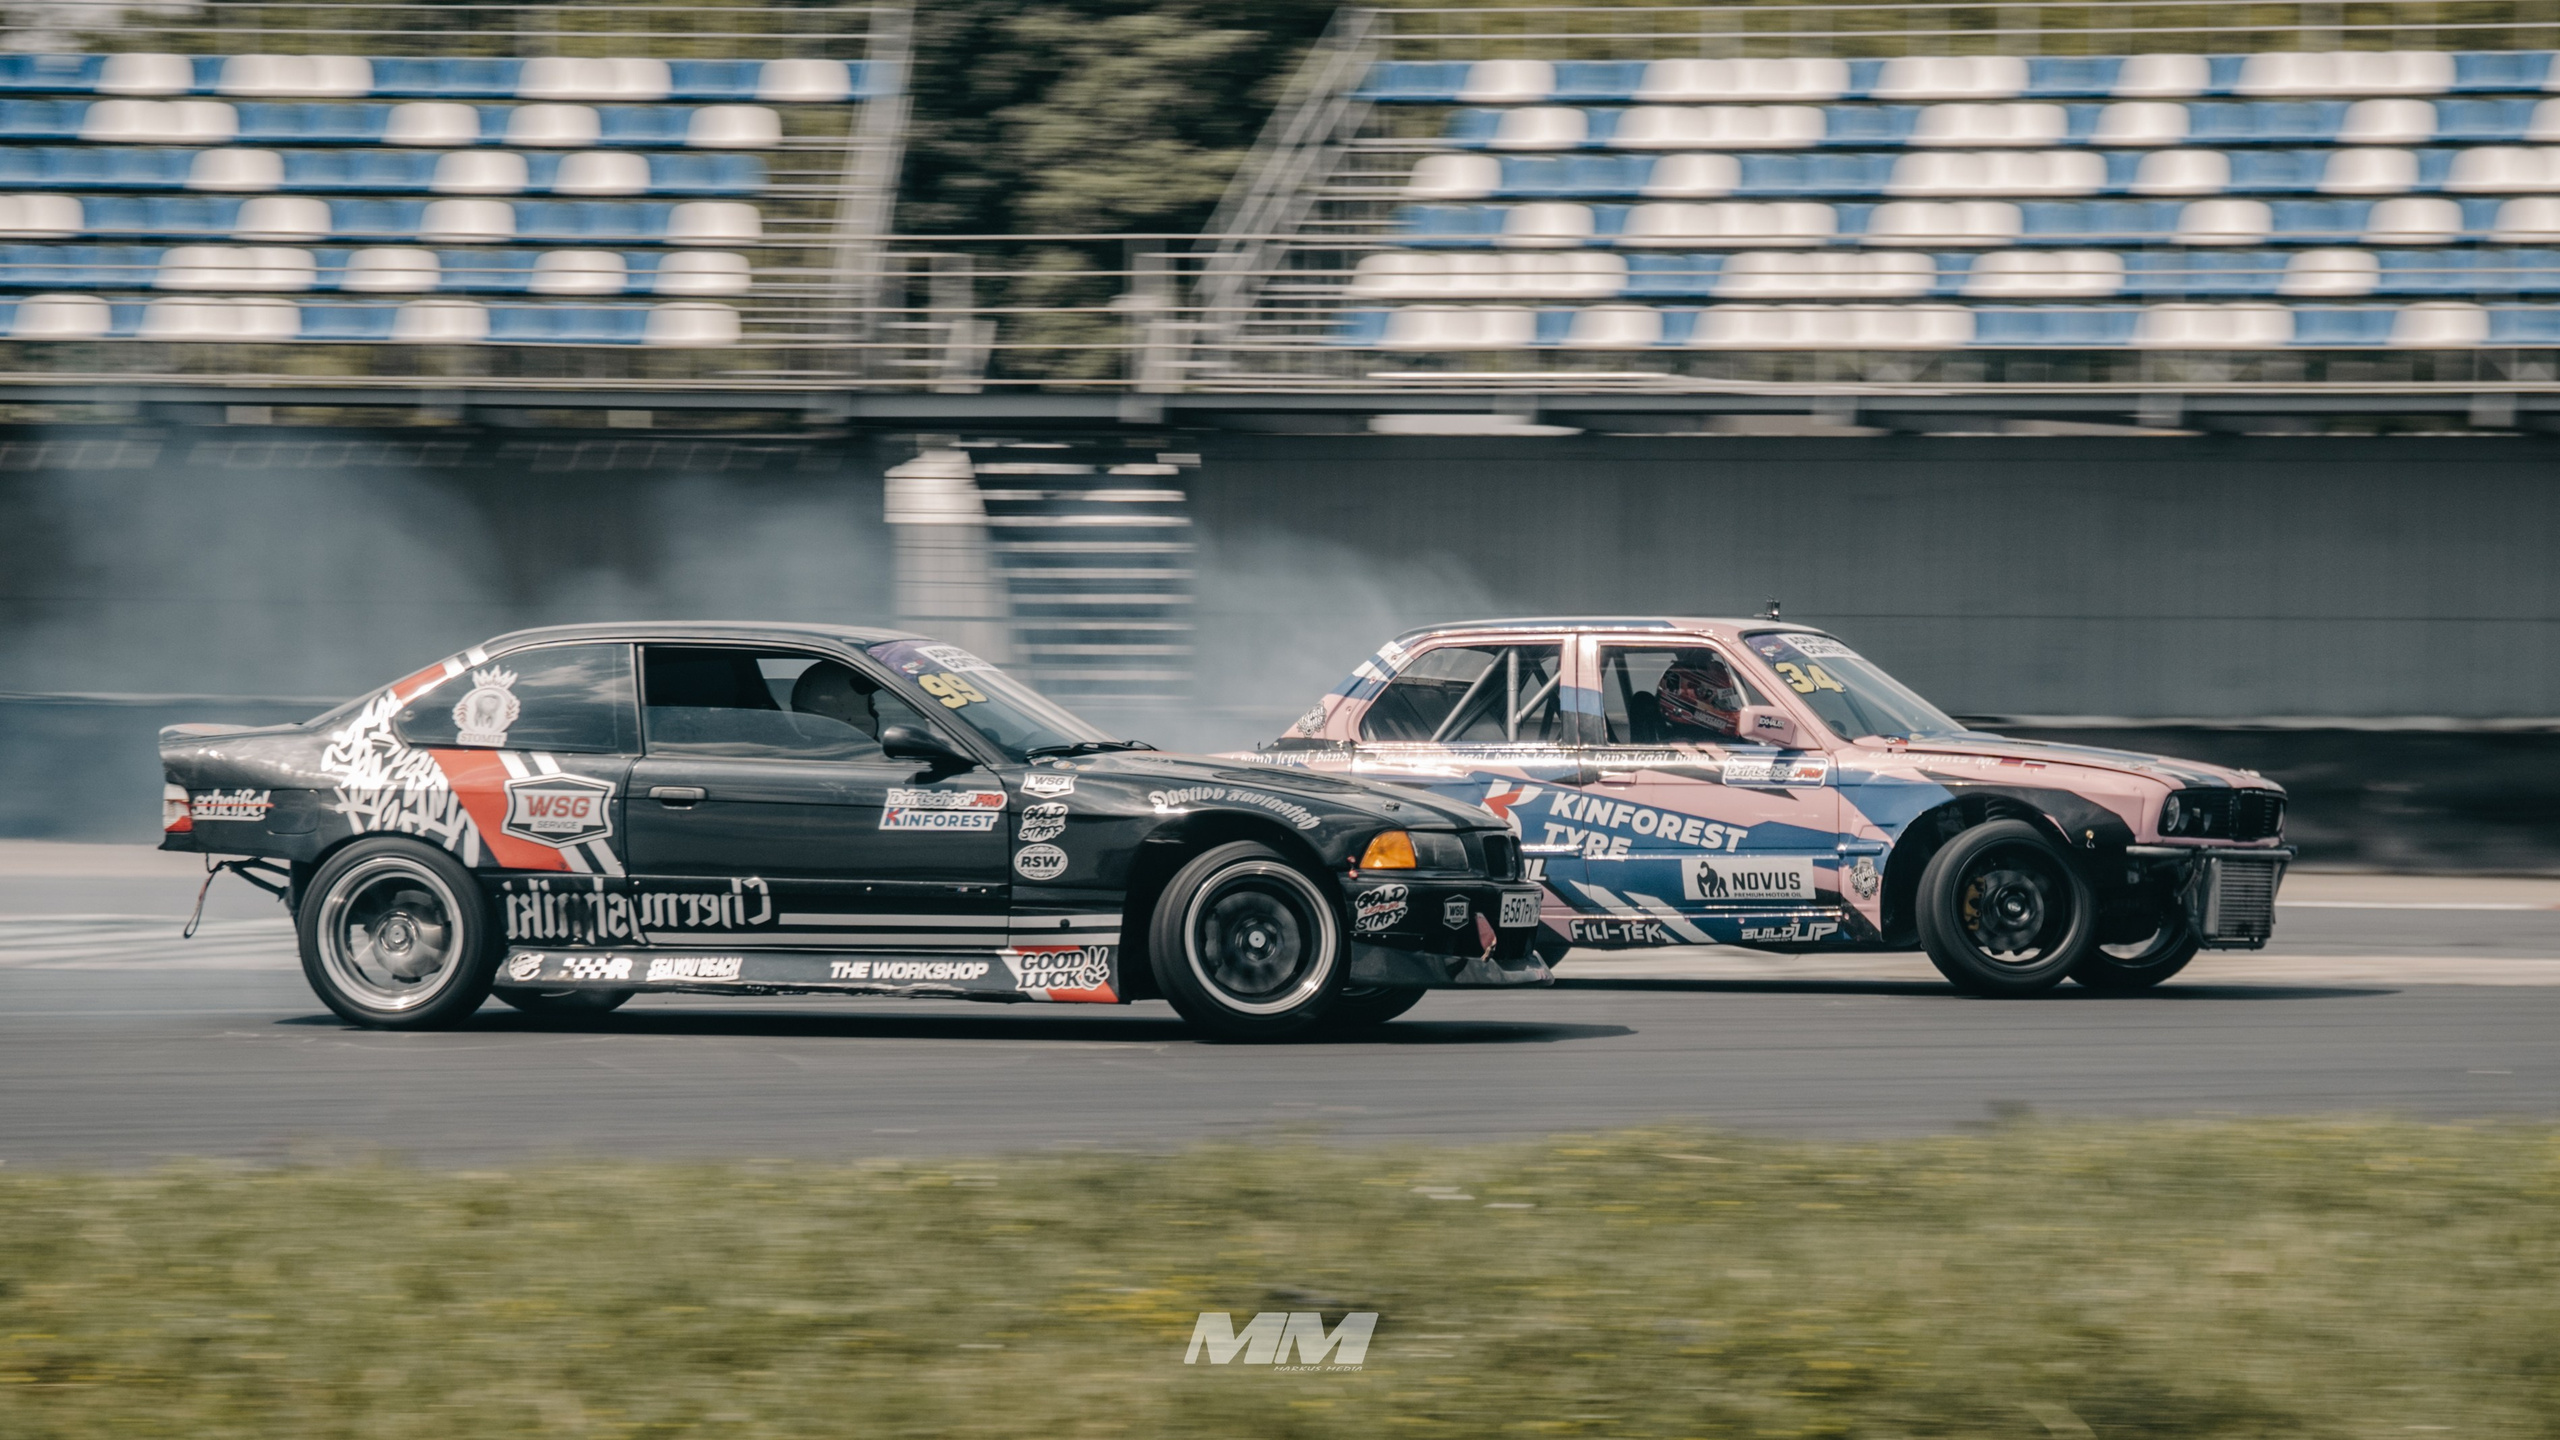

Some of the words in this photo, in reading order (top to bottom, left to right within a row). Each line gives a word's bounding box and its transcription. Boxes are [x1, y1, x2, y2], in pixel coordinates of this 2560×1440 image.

[1775, 662, 1845, 693] 34
[918, 672, 988, 709] 99
[1276, 750, 1310, 767] legal
[1868, 752, 1970, 764] Davidyants
[1035, 776, 1065, 786] WSG
[525, 795, 591, 818] WSG
[1023, 805, 1065, 820] GOLD
[537, 820, 578, 829] SERVICE
[884, 808, 994, 828] KINFOREST
[1549, 791, 1748, 854] KINFOREST
[1020, 825, 1063, 839] STAFF
[1543, 821, 1632, 862] TYRE
[1020, 856, 1061, 868] RSW
[1732, 871, 1801, 890] NOVUS
[1357, 886, 1407, 909] GOLD
[1356, 907, 1407, 930] STAFF
[1449, 905, 1465, 917] WSG
[1570, 919, 1661, 943] FILI-TEK
[1020, 950, 1085, 970] GOOD
[830, 961, 868, 978] THE
[871, 961, 989, 979] WORKSHOP
[1019, 970, 1082, 989] LUCK
